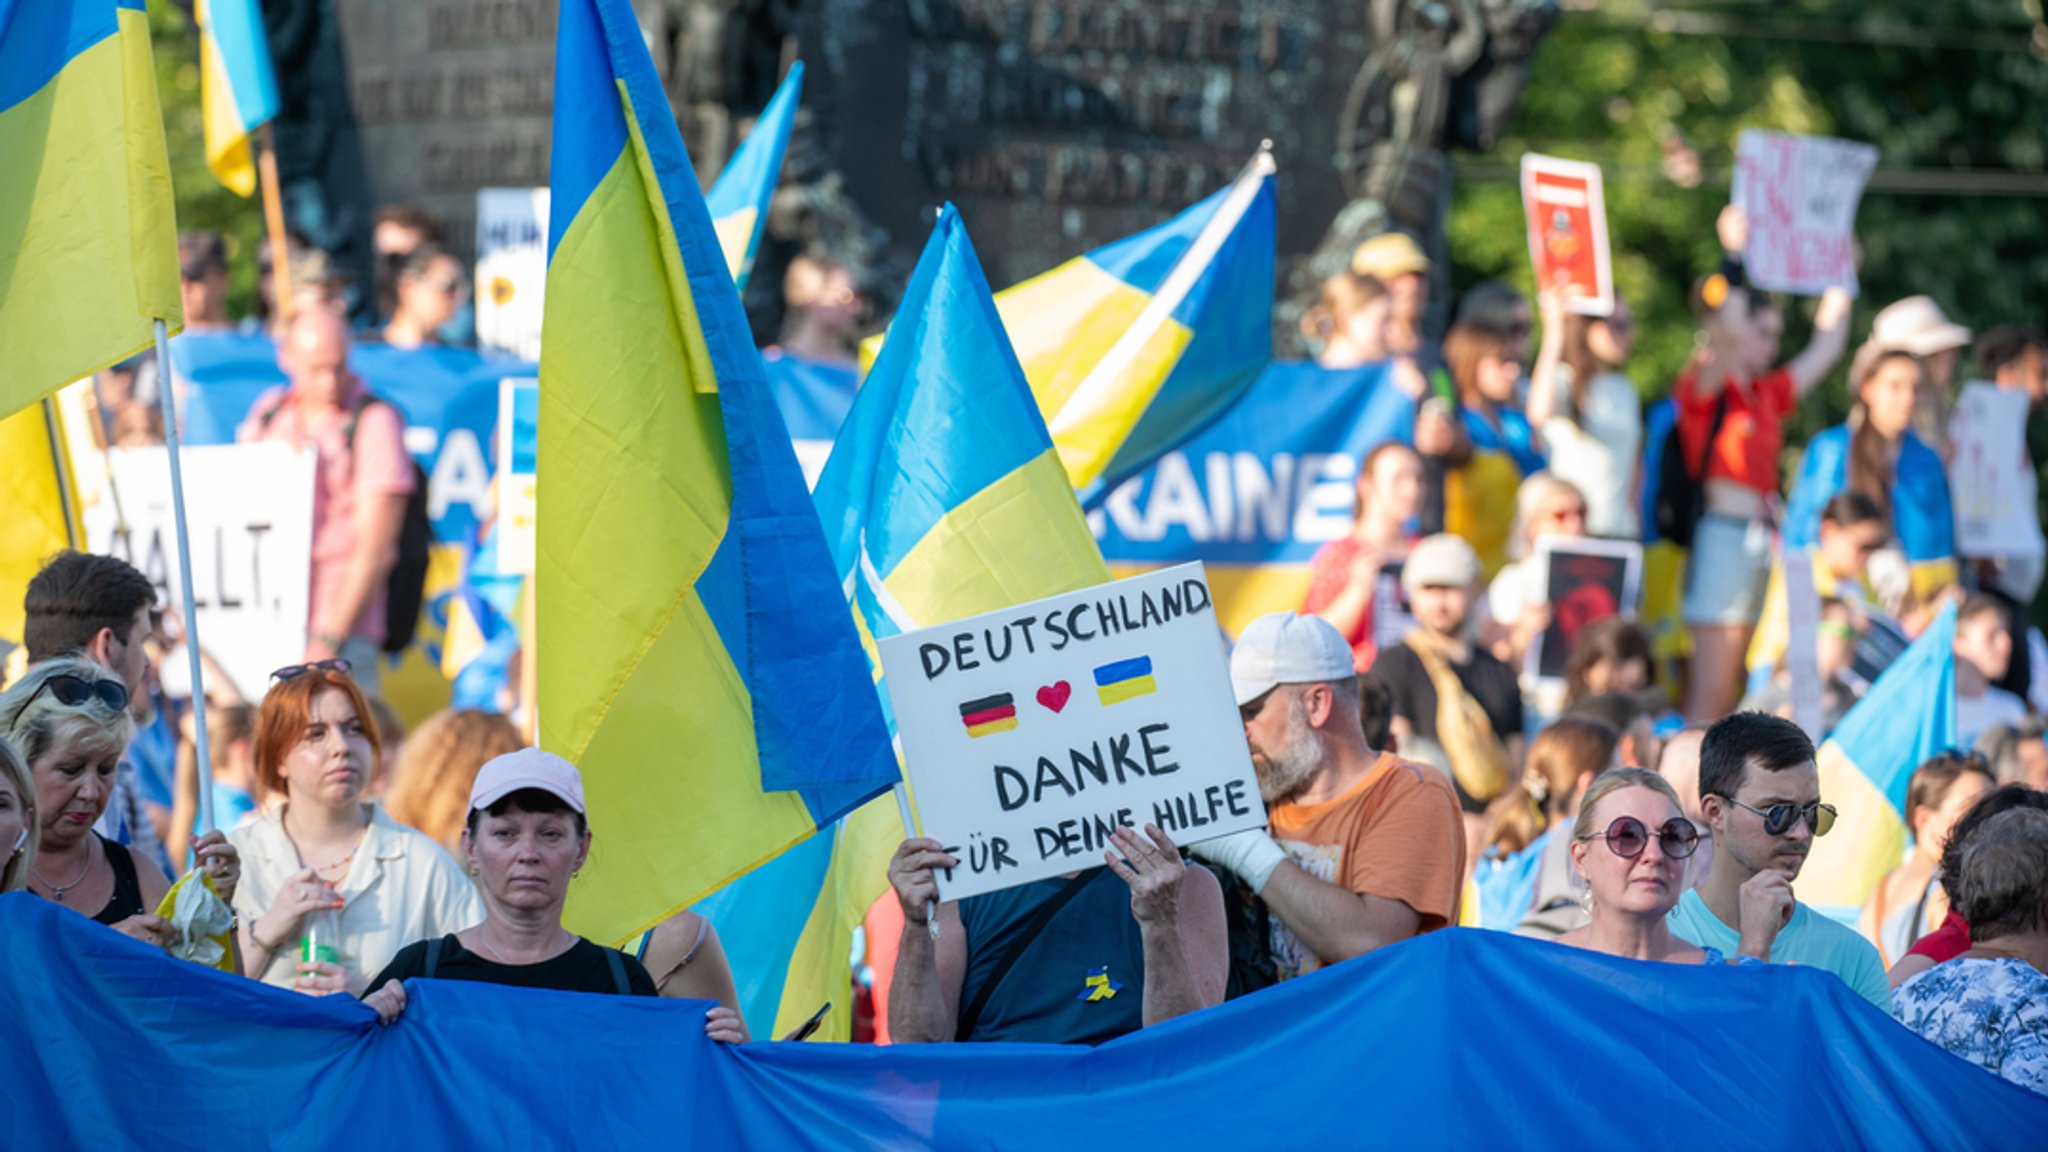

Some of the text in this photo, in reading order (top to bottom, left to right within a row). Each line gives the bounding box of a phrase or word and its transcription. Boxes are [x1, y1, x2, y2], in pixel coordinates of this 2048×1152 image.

[919, 578, 1212, 680] DEUTSCHLAND
[993, 722, 1180, 812] DANKE
[941, 833, 1018, 882] FÜR
[1152, 779, 1251, 833] HILFE
